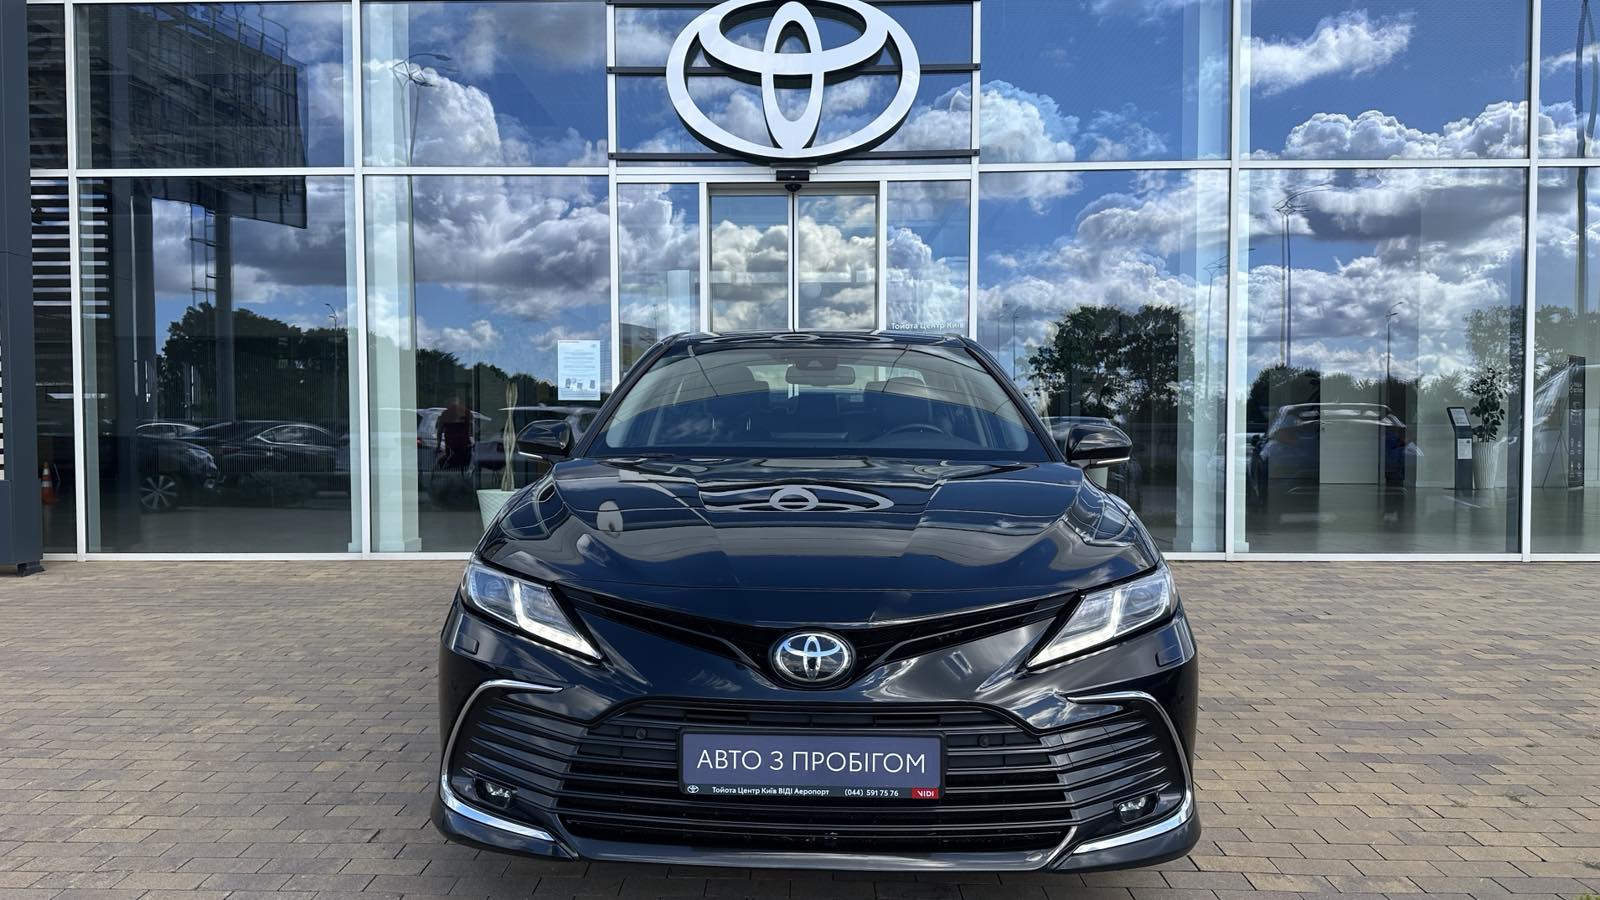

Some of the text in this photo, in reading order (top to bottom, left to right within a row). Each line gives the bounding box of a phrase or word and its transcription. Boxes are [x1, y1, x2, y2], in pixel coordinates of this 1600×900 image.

[891, 322, 918, 330] Тойота
[696, 749, 762, 770] АВТО
[792, 751, 926, 774] ПРОБІГОМ
[712, 786, 830, 797] Тойота Центр Київ ВІДІ Аеропорт
[844, 788, 864, 797] (044)
[866, 789, 878, 797] 591
[917, 790, 935, 798] VIDI
